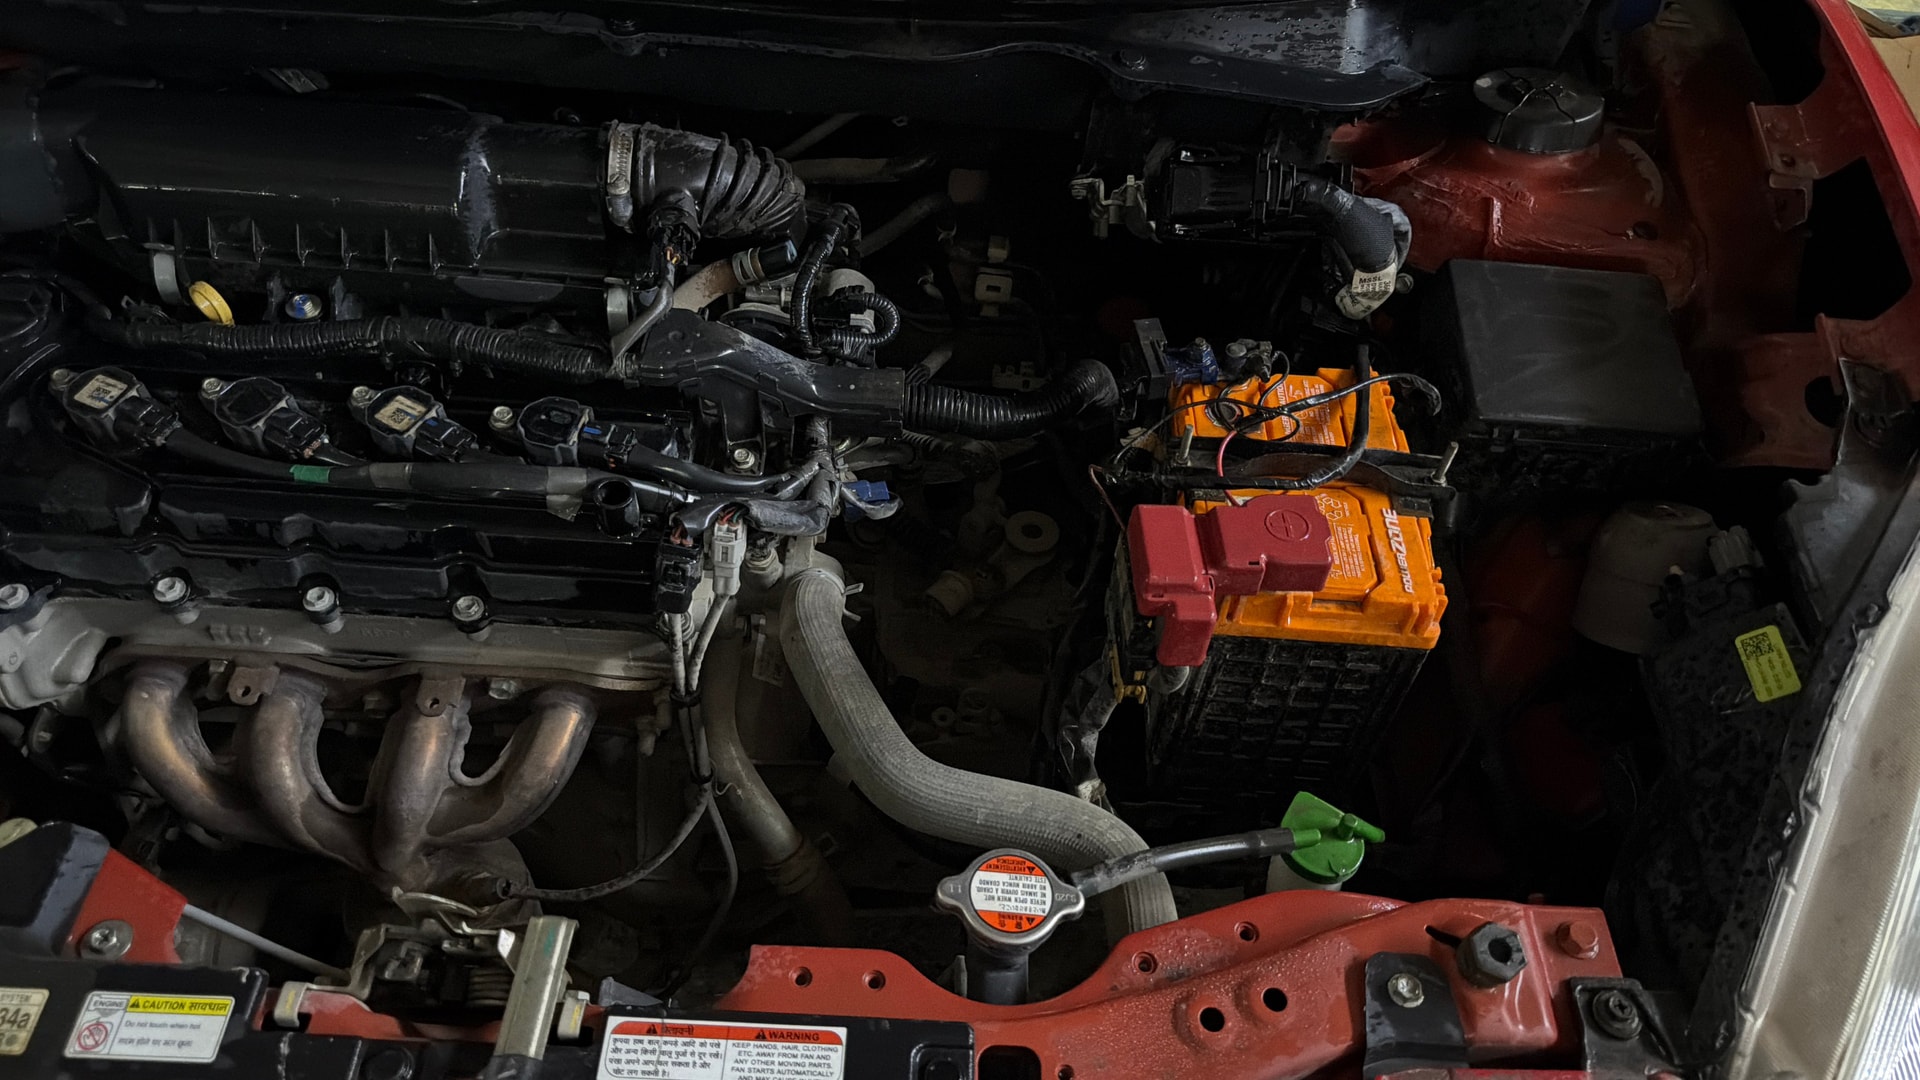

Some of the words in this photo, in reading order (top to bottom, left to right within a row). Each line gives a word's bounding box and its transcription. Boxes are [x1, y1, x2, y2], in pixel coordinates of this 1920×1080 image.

[1382, 507, 1414, 594] POWERZONE
[979, 879, 1000, 887] CUANDO
[1002, 881, 1019, 889] NUNCA
[142, 1001, 185, 1009] CAUTION
[189, 1002, 229, 1011] सावधान
[769, 1032, 819, 1041] WARNING
[777, 1069, 834, 1077] AUTOMATICALLY
